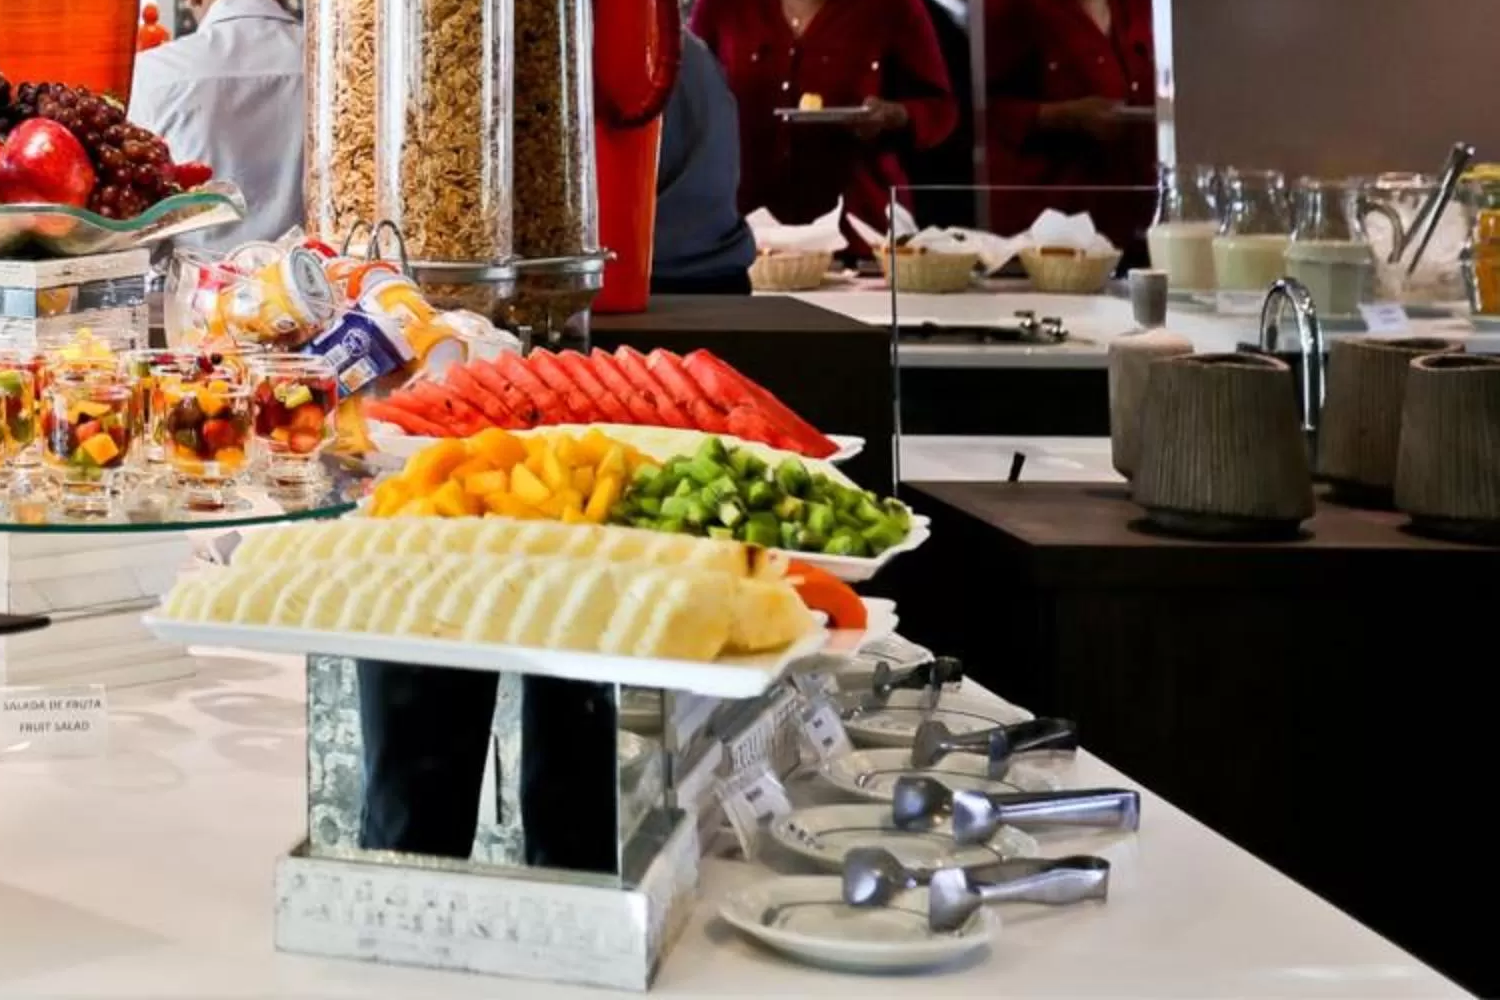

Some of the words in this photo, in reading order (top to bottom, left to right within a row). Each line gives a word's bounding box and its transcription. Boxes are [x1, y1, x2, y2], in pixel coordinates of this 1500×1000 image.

[3, 700, 45, 711] SALADA
[49, 700, 62, 710] DE
[65, 699, 102, 710] FRUTA
[19, 721, 50, 733] FRUIT
[54, 720, 91, 732] SALAD
